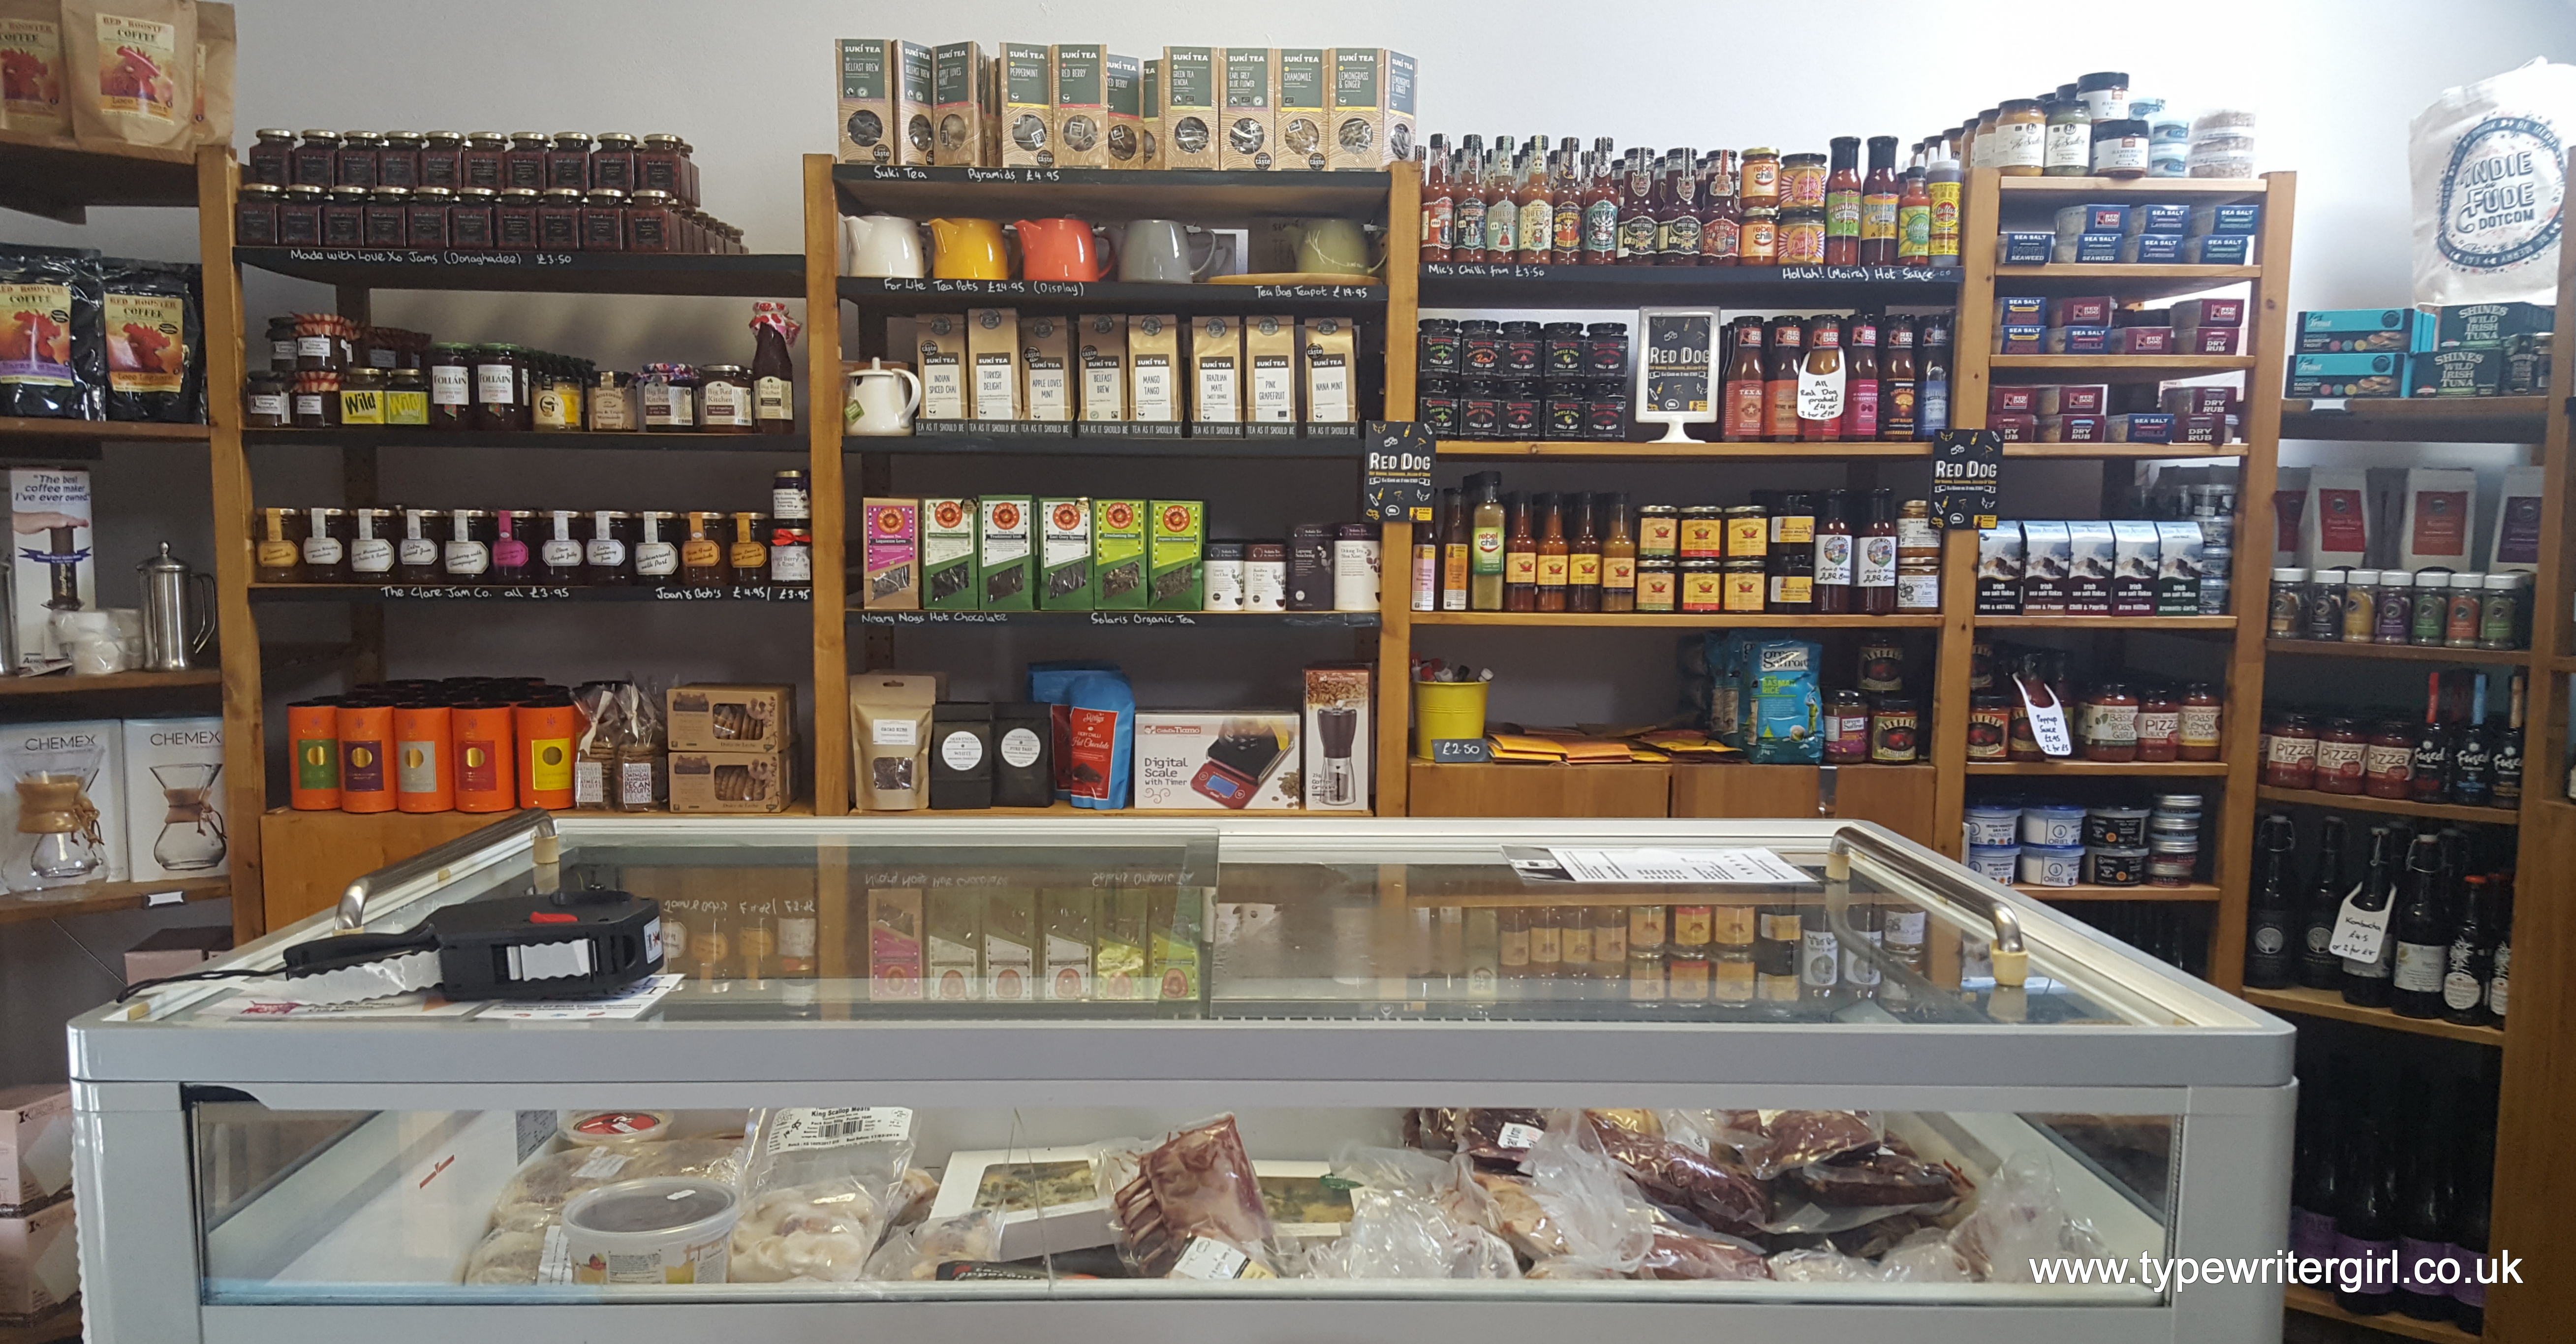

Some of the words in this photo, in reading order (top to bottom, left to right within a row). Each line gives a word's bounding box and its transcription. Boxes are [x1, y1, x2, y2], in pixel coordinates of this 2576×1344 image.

[846, 63, 864, 72] BELFAST
[866, 63, 879, 72] BREW
[1010, 67, 1038, 77] PEPPERMINT
[1062, 69, 1070, 77] RED
[1073, 69, 1086, 77] BERRY
[1284, 73, 1312, 81] CHAMOMILE
[1339, 72, 1368, 80] LEMONGRASS
[1344, 80, 1360, 89] GINGER
[874, 165, 900, 179] Suki
[903, 168, 927, 179] Tea
[968, 168, 1015, 182] Pyramids
[1026, 171, 1059, 182] £4.95
[2465, 151, 2533, 188] INDIE
[2479, 208, 2535, 230] DOTCOM
[291, 250, 323, 261] Made
[327, 250, 355, 261] with
[358, 250, 385, 262] Love
[388, 250, 403, 262] Xo
[409, 250, 437, 264] Jams
[444, 250, 521, 265] (Donaghadee)
[1428, 264, 1454, 275] Mic's
[1459, 265, 1486, 275] Chilli
[1490, 266, 1509, 277] from
[1783, 267, 1824, 280] Hollah!
[1828, 266, 1869, 281] (Moira)
[1875, 267, 1895, 280] Hot
[884, 279, 901, 290] For
[933, 280, 954, 291] Tea
[956, 281, 978, 291] Pots
[987, 283, 1024, 293] £24.95
[1034, 282, 1084, 296] (Display)
[1255, 285, 1272, 298] Tea
[1275, 285, 1292, 297] Bag
[1294, 285, 1327, 296] Teapot
[2458, 305, 2509, 318] SHINES
[2468, 315, 2498, 323] WILD
[2467, 323, 2498, 332] IRISH
[2465, 331, 2498, 340] TUNA
[1650, 346, 1677, 364] RED
[984, 371, 1001, 379] TURKISH
[1094, 374, 1112, 383] BELFAST
[930, 385, 944, 394] SPICED
[1144, 386, 1159, 395] TANGO
[1331, 382, 1342, 390] MINT
[708, 388, 718, 396] Big
[1259, 392, 1285, 400] GRAPEFRUIT
[1822, 389, 1838, 399] Dog
[345, 392, 376, 414] Wild
[1369, 452, 1397, 470] RED
[1401, 453, 1431, 470] DOG
[1934, 460, 1963, 478] RED
[1966, 460, 1997, 478] DOG
[63, 475, 78, 484] best
[26, 484, 61, 493] coffee
[15, 493, 35, 502] I've
[381, 587, 404, 598] The
[410, 587, 442, 598] Clare
[447, 587, 470, 598] Jam
[474, 587, 492, 598] Co.
[505, 588, 523, 598] all
[530, 588, 569, 598] £3.95
[656, 587, 683, 599] Joan
[695, 587, 721, 598] Bob's
[862, 612, 894, 625] Neary
[899, 613, 924, 624] Nogs
[930, 612, 949, 621] Hot
[954, 612, 1008, 622] Chocolate
[1091, 613, 1128, 624] Solaris
[1134, 614, 1175, 625] Organic
[1176, 615, 1195, 624] Tea
[25, 735, 95, 750] CHEMEX
[150, 731, 221, 746] CHEMEX
[1084, 738, 1110, 750] Chocolate
[1442, 742, 1480, 755] £2.50
[1145, 757, 1188, 769] Digital
[1145, 768, 1178, 778] Scale
